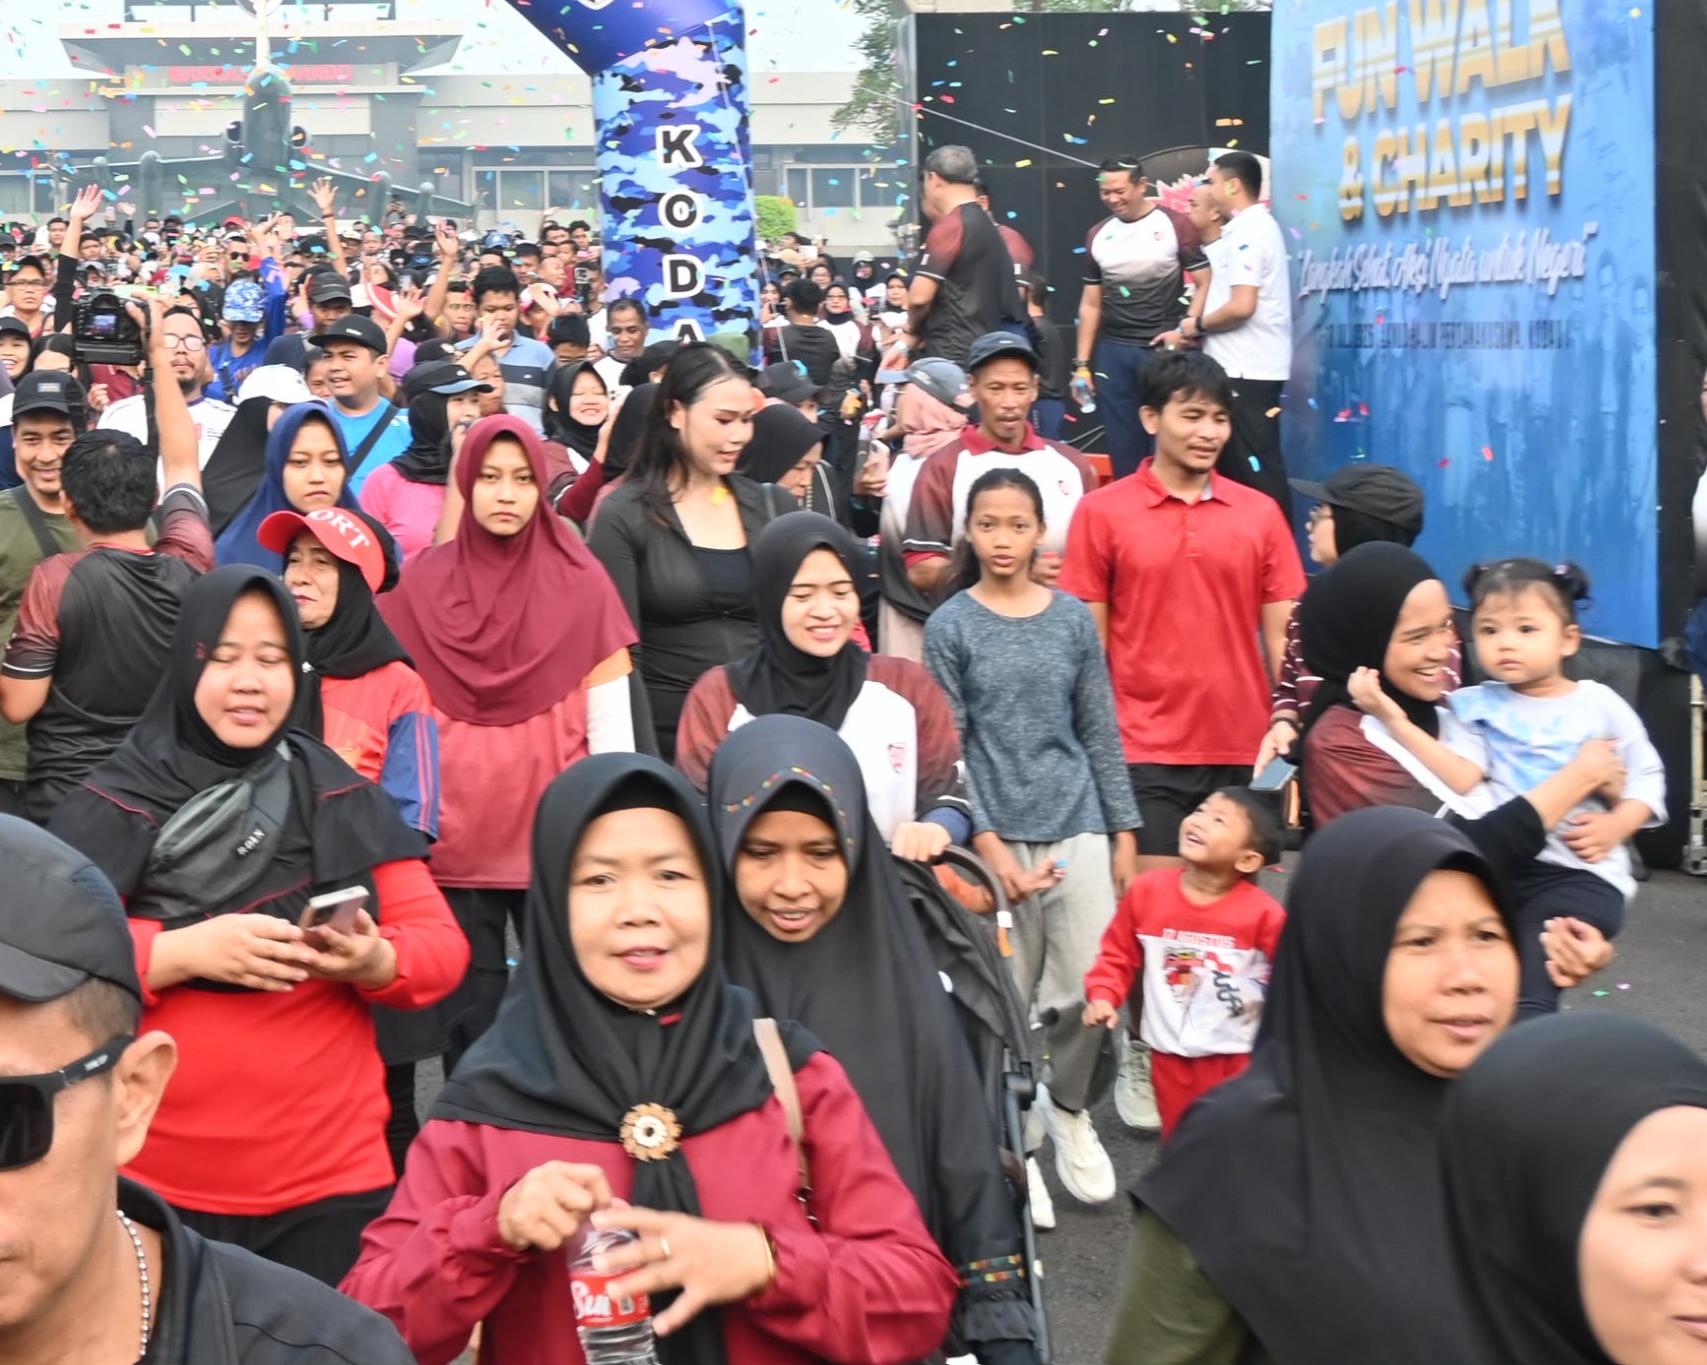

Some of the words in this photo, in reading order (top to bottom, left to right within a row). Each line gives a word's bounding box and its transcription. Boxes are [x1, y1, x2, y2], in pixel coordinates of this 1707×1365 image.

[1313, 0, 1398, 123] FUN
[1339, 136, 1364, 220] &
[1372, 93, 1573, 217] CHARITY
[309, 509, 370, 548] ORT
